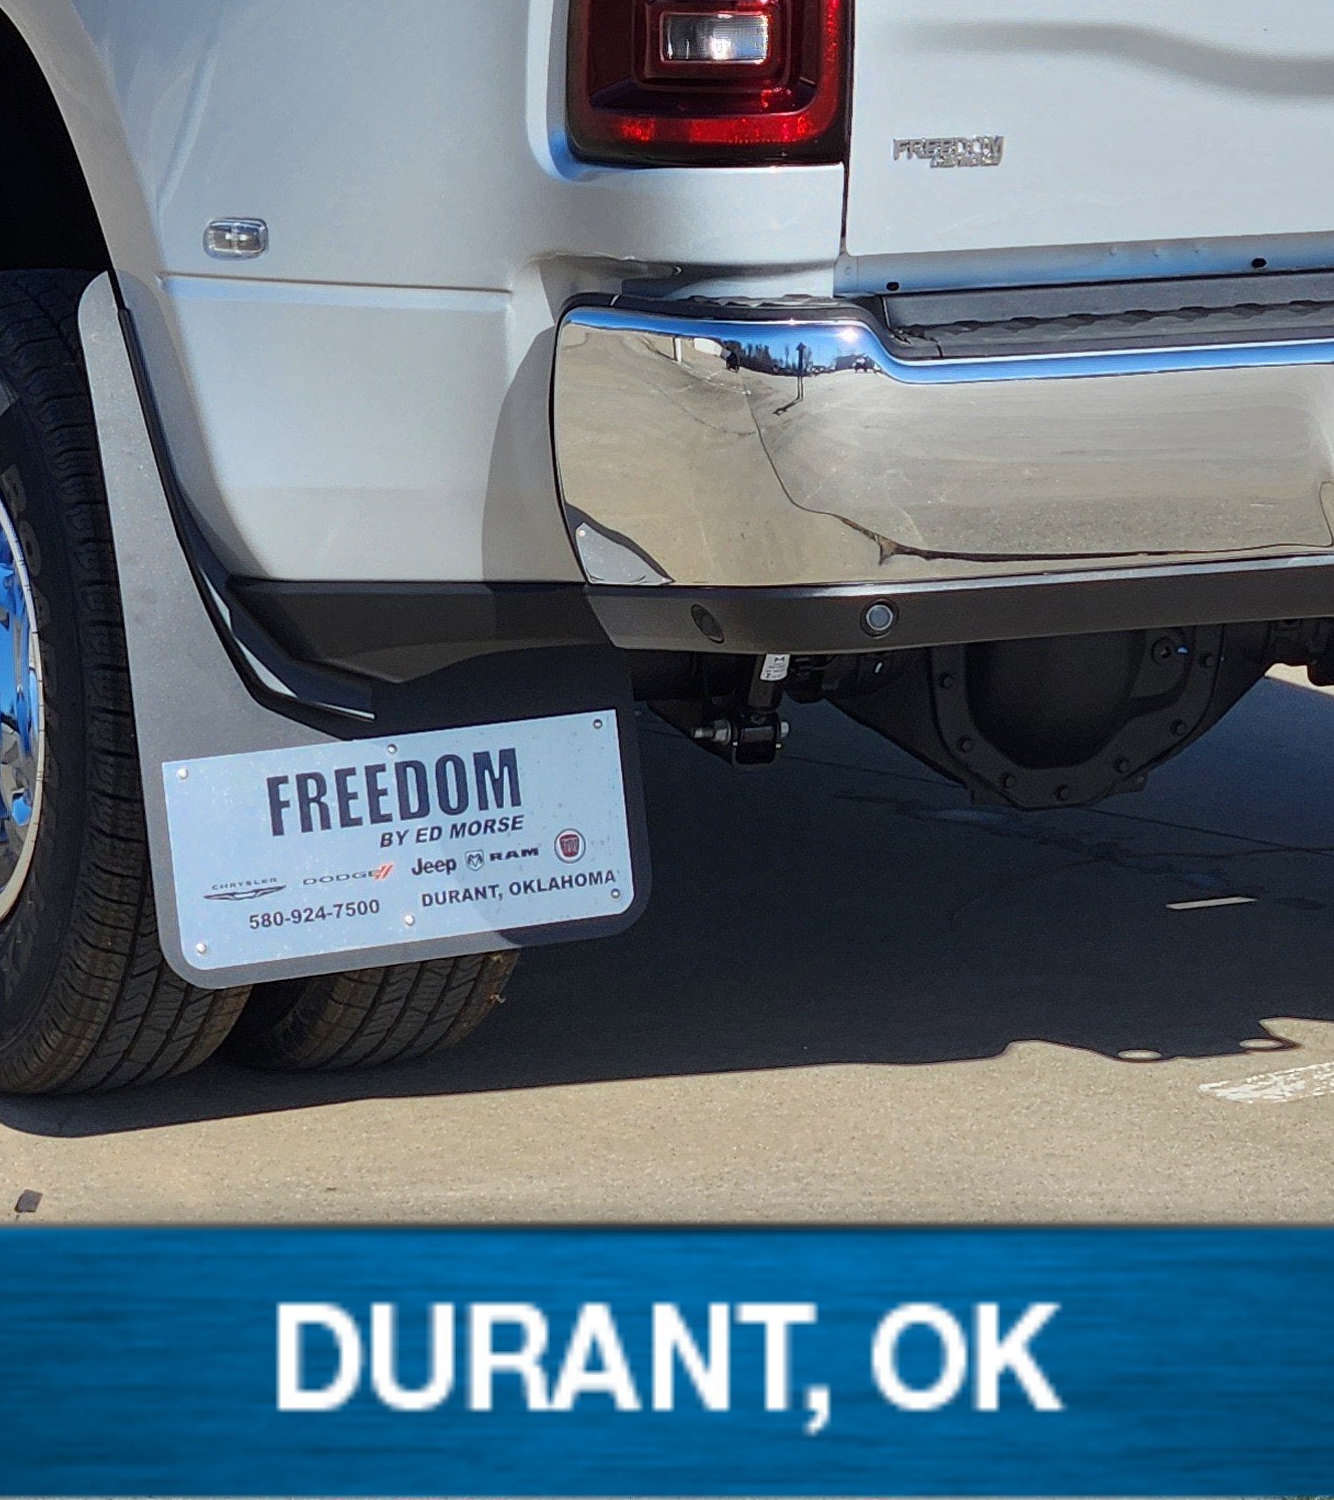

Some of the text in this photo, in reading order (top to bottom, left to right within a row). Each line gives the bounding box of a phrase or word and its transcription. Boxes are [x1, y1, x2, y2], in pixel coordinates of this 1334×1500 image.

[266, 747, 522, 836] FREEDOM
[380, 814, 525, 849] BY ED MORSE
[211, 847, 540, 890] CHRYSLER DODGE Jeep RAM
[422, 869, 617, 907] DURANT, OKLAHOMA
[249, 899, 380, 930] 580-924-7500
